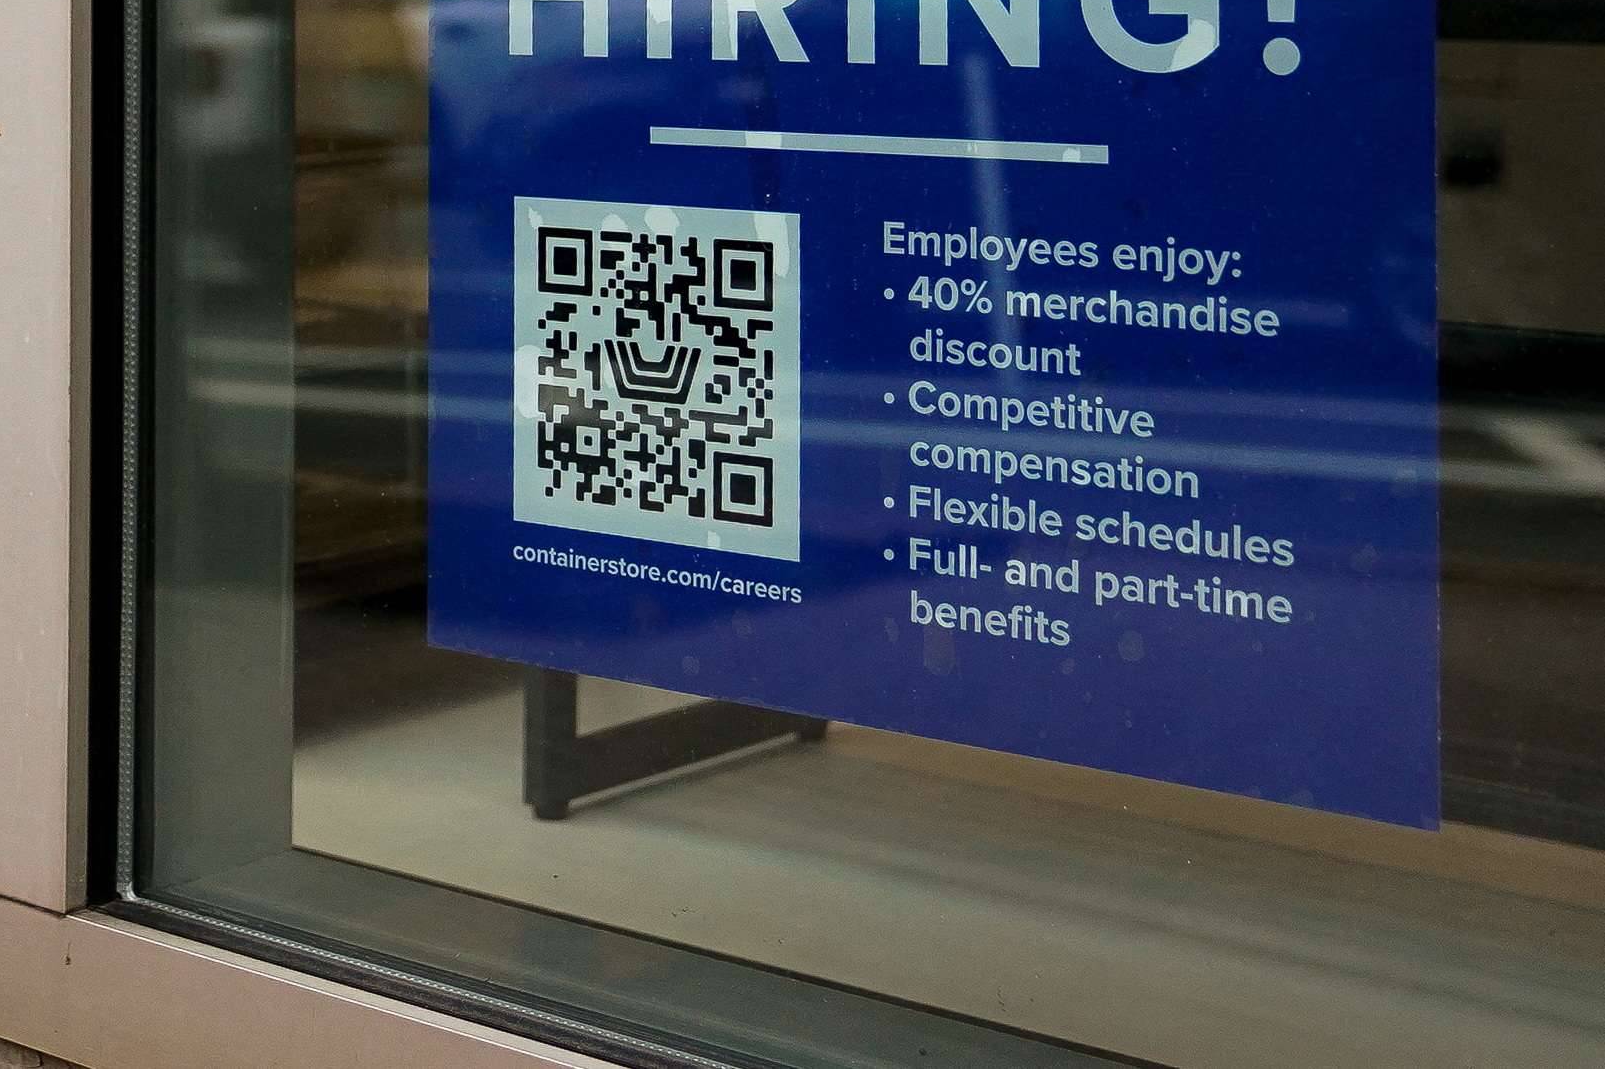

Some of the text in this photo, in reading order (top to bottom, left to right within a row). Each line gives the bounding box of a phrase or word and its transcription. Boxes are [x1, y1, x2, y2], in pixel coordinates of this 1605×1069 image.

[883, 221, 1243, 285] Employees enjoy:
[907, 275, 1281, 338] 40% merchandise
[909, 328, 1082, 377] discount
[907, 381, 1155, 438] Competitive
[909, 439, 1199, 499] compensation
[908, 485, 1296, 567] Flexible schedules
[512, 543, 803, 604] containerstore.com/careers
[908, 537, 1294, 624] Full- and part-time
[909, 590, 1071, 647] benefits
